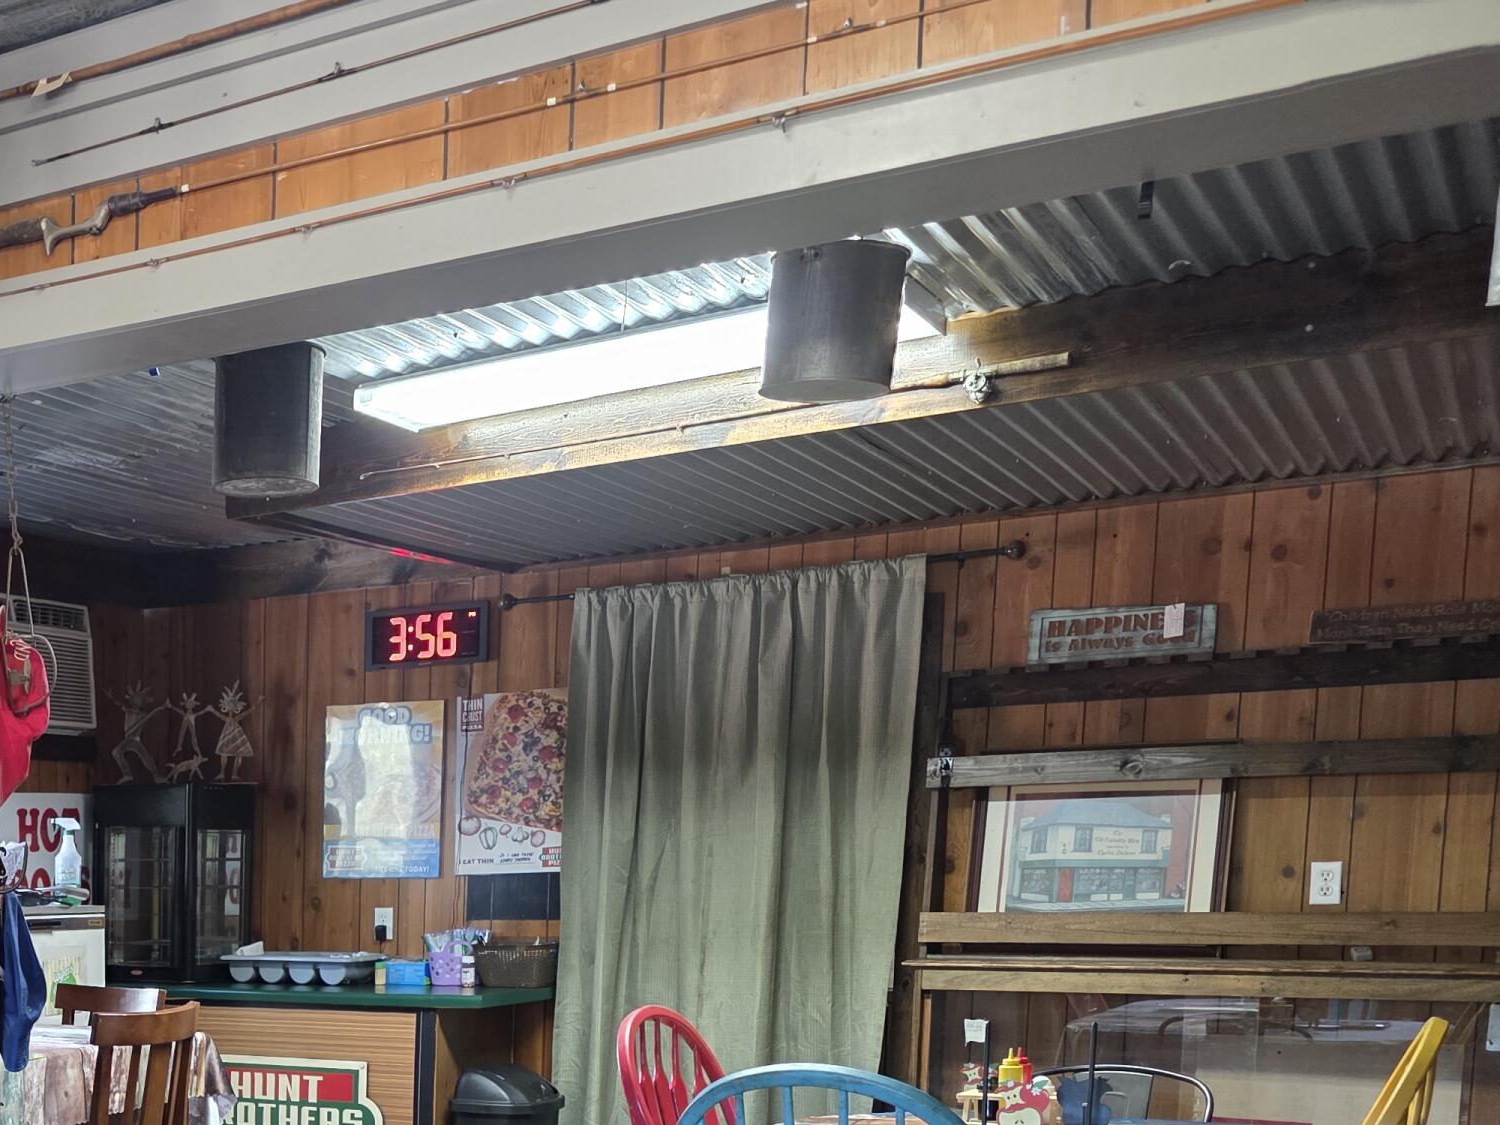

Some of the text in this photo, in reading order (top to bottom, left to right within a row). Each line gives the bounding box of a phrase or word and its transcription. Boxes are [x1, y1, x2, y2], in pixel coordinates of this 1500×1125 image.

[1047, 609, 1197, 638] HAPPINES
[388, 611, 458, 661] 3:56
[1068, 635, 1135, 653] Always
[463, 699, 483, 711] THIN
[405, 865, 430, 873] TODAY!
[230, 1071, 324, 1103] HUNT
